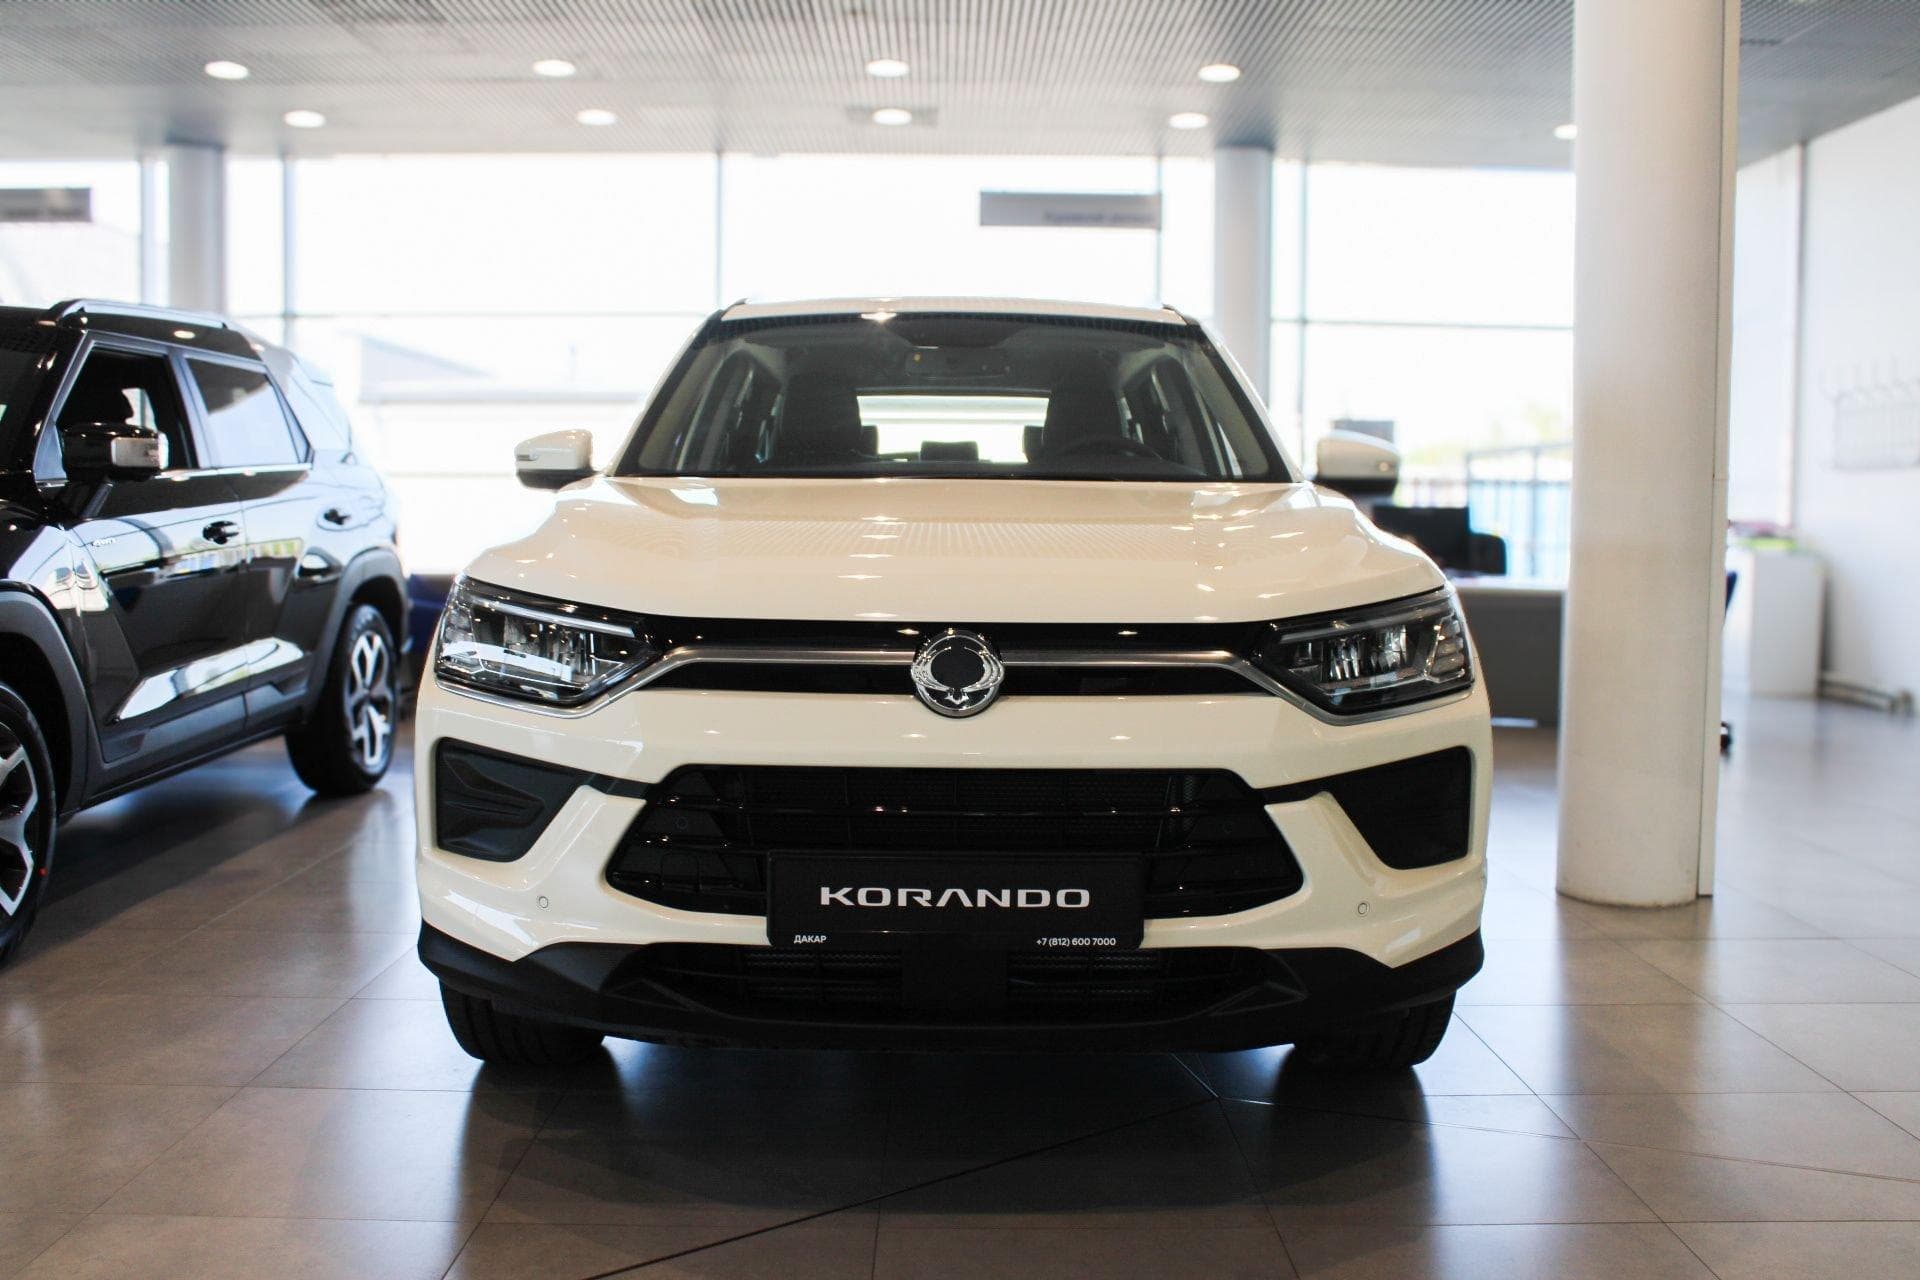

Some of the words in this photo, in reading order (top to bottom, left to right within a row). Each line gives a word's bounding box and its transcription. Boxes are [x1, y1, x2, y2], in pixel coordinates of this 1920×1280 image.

[820, 886, 1090, 908] KORANDO
[793, 934, 827, 944] ДАКАР
[1036, 937, 1048, 946] +7
[1048, 937, 1070, 947] (812)
[1071, 937, 1091, 946] 600
[1091, 937, 1117, 946] 7000
